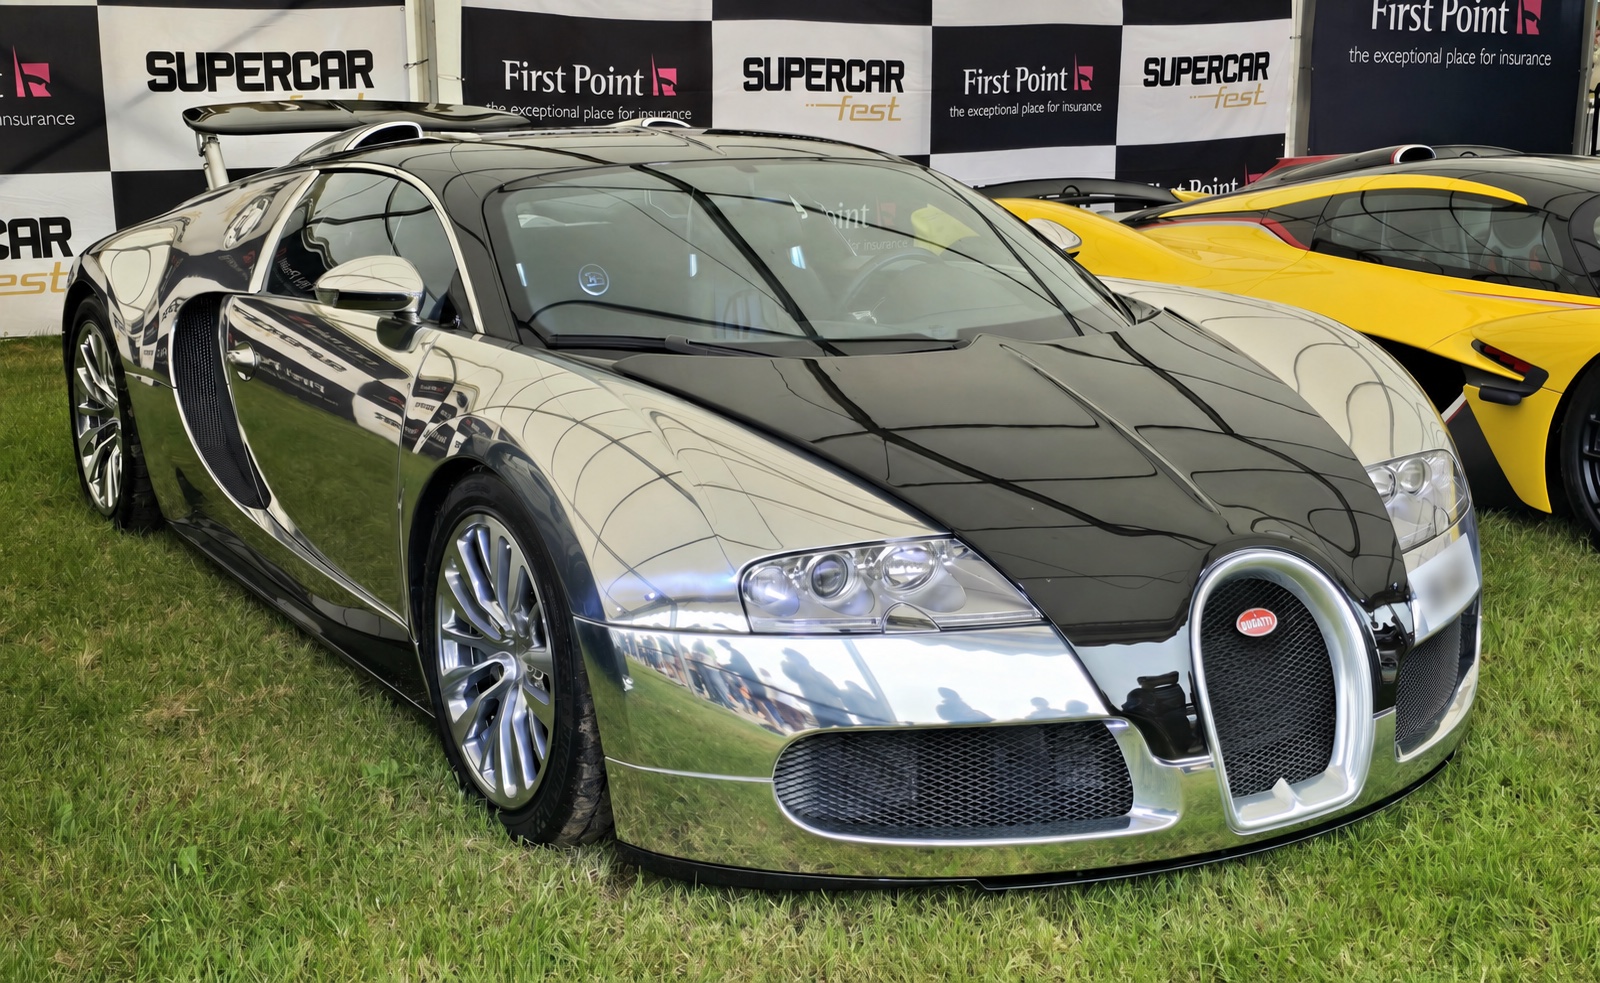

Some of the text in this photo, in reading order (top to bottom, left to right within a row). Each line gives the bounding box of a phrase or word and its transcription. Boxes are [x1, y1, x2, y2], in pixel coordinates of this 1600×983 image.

[1371, 0, 1510, 34] First Point
[145, 50, 375, 92] SUPERCAR
[1143, 51, 1270, 87] SUPERCAR
[1349, 46, 1552, 69] the exceptional place for insurance
[502, 59, 645, 97] First Point
[743, 56, 905, 93] SUPERCAR
[963, 65, 1068, 95] First Point
[817, 95, 902, 122] fest
[949, 100, 1103, 119] the exceptional place for insurance
[1200, 83, 1267, 109] fest
[510, 104, 580, 121] exceptional
[584, 105, 615, 122] place
[618, 105, 635, 119] for
[638, 107, 692, 120] insurance
